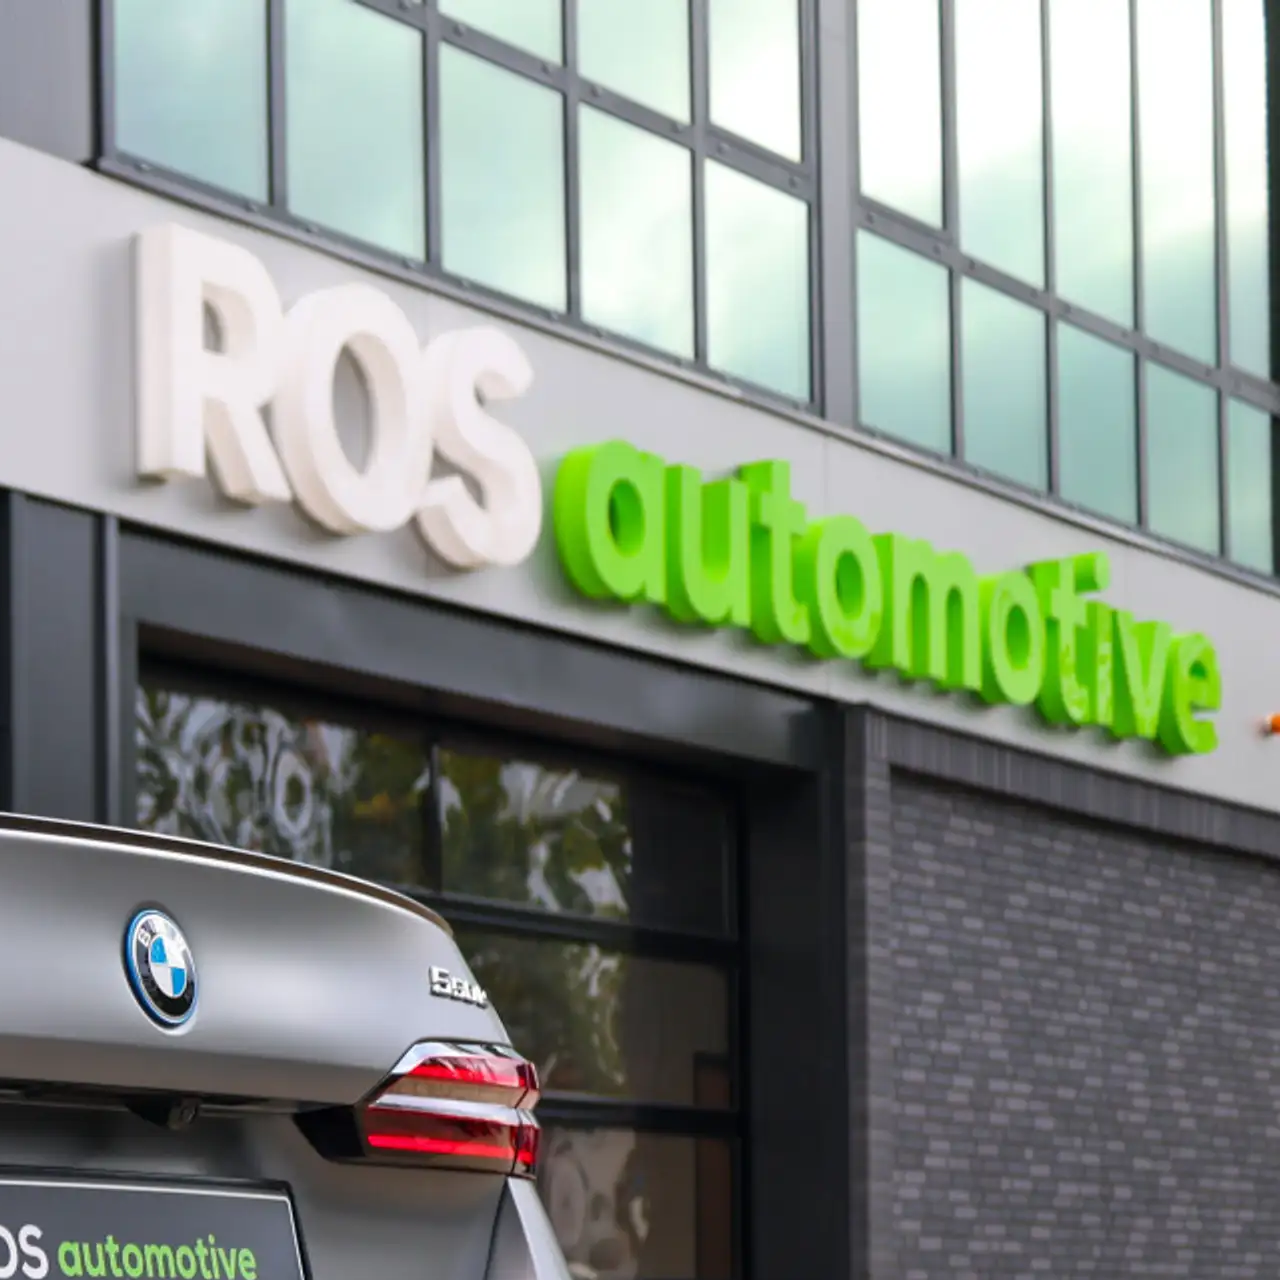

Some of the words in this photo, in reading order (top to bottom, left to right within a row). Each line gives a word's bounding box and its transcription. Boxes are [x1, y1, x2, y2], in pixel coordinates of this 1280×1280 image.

[137, 224, 543, 567] ROS
[553, 438, 1222, 754] automotive
[58, 1235, 257, 1280] automotive
